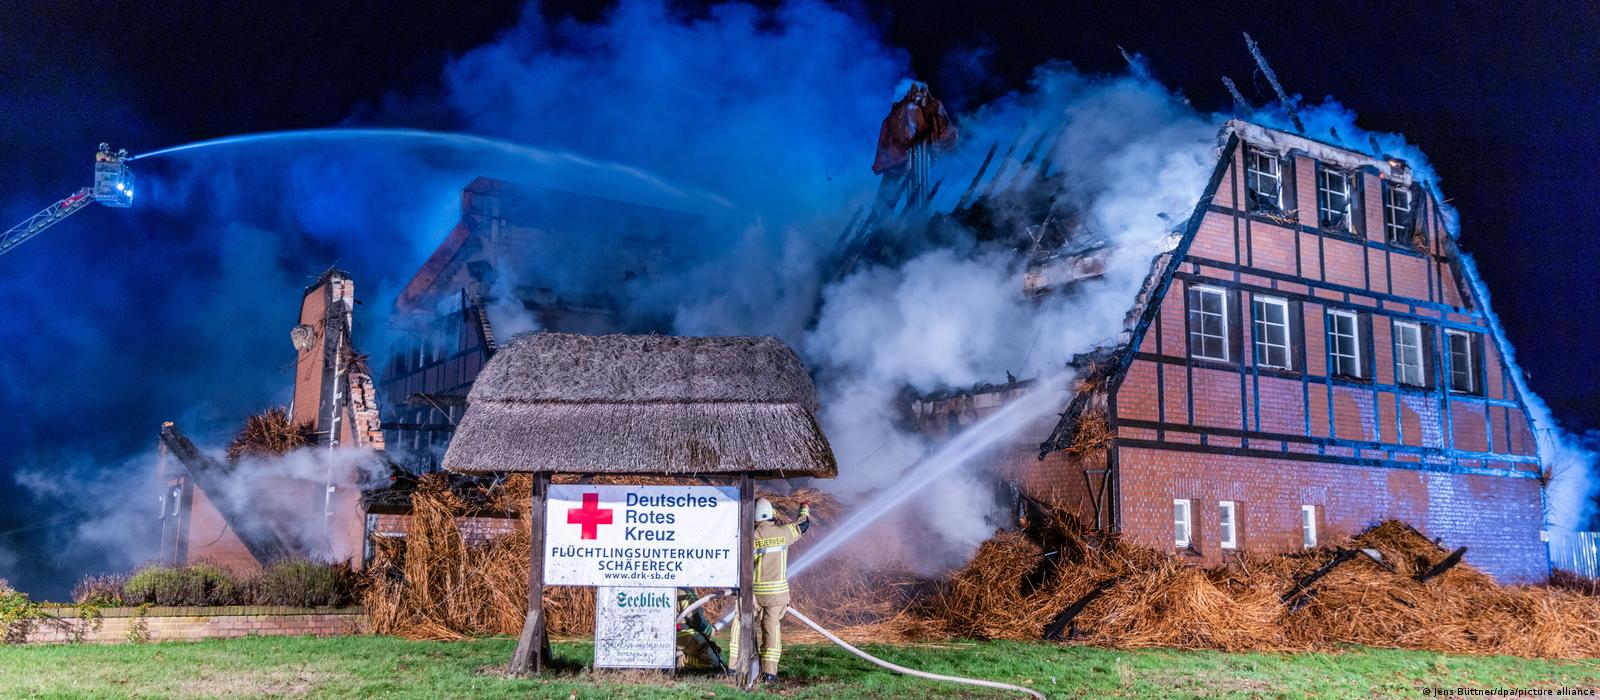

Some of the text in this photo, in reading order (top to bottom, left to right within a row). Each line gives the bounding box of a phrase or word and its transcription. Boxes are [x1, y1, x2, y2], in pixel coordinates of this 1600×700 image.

[626, 493, 718, 508] Deutsches
[625, 510, 676, 524] Rotes
[625, 526, 676, 541] Kreuz
[755, 537, 786, 548] FEUERWEHR
[552, 545, 730, 559] FLÜCHTLINGSUNTERKUNFT
[598, 559, 683, 572] SCHÄFERECK
[604, 571, 676, 580] www.drk-sb.de
[616, 591, 671, 609] Seeblick
